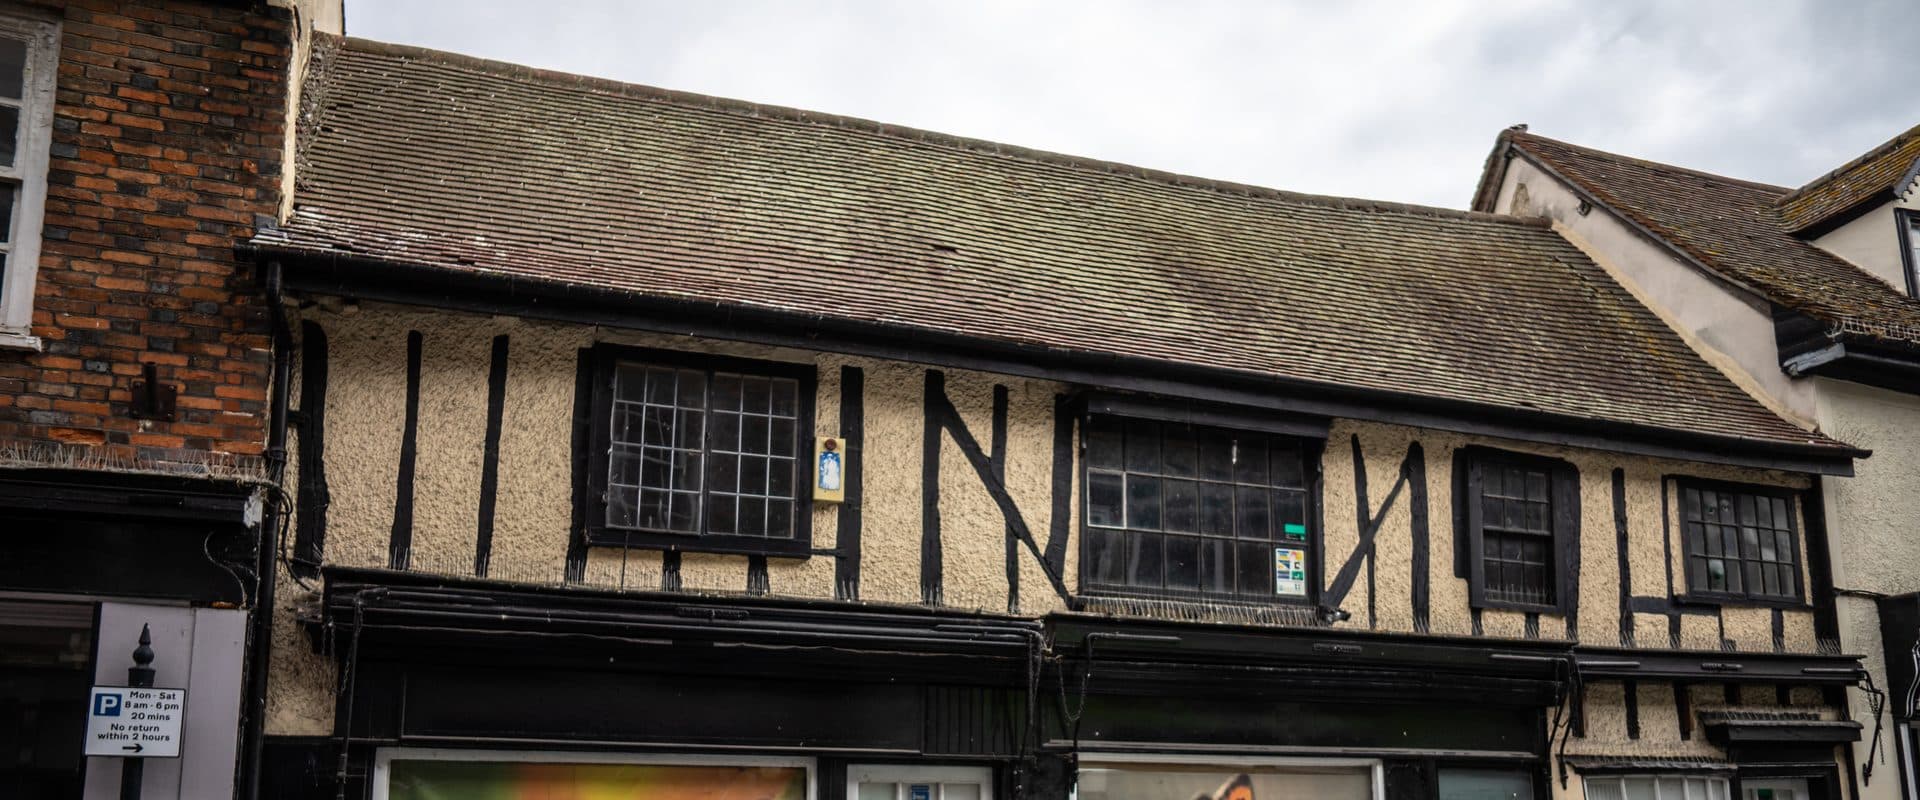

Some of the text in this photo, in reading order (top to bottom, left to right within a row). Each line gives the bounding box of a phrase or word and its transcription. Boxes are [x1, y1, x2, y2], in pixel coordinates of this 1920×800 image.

[130, 691, 151, 699] Mon
[159, 692, 176, 700] Sat
[100, 695, 118, 714] P
[164, 703, 179, 711] pm
[131, 712, 170, 721] 20 mins
[111, 723, 125, 731] No
[98, 732, 129, 740] within
